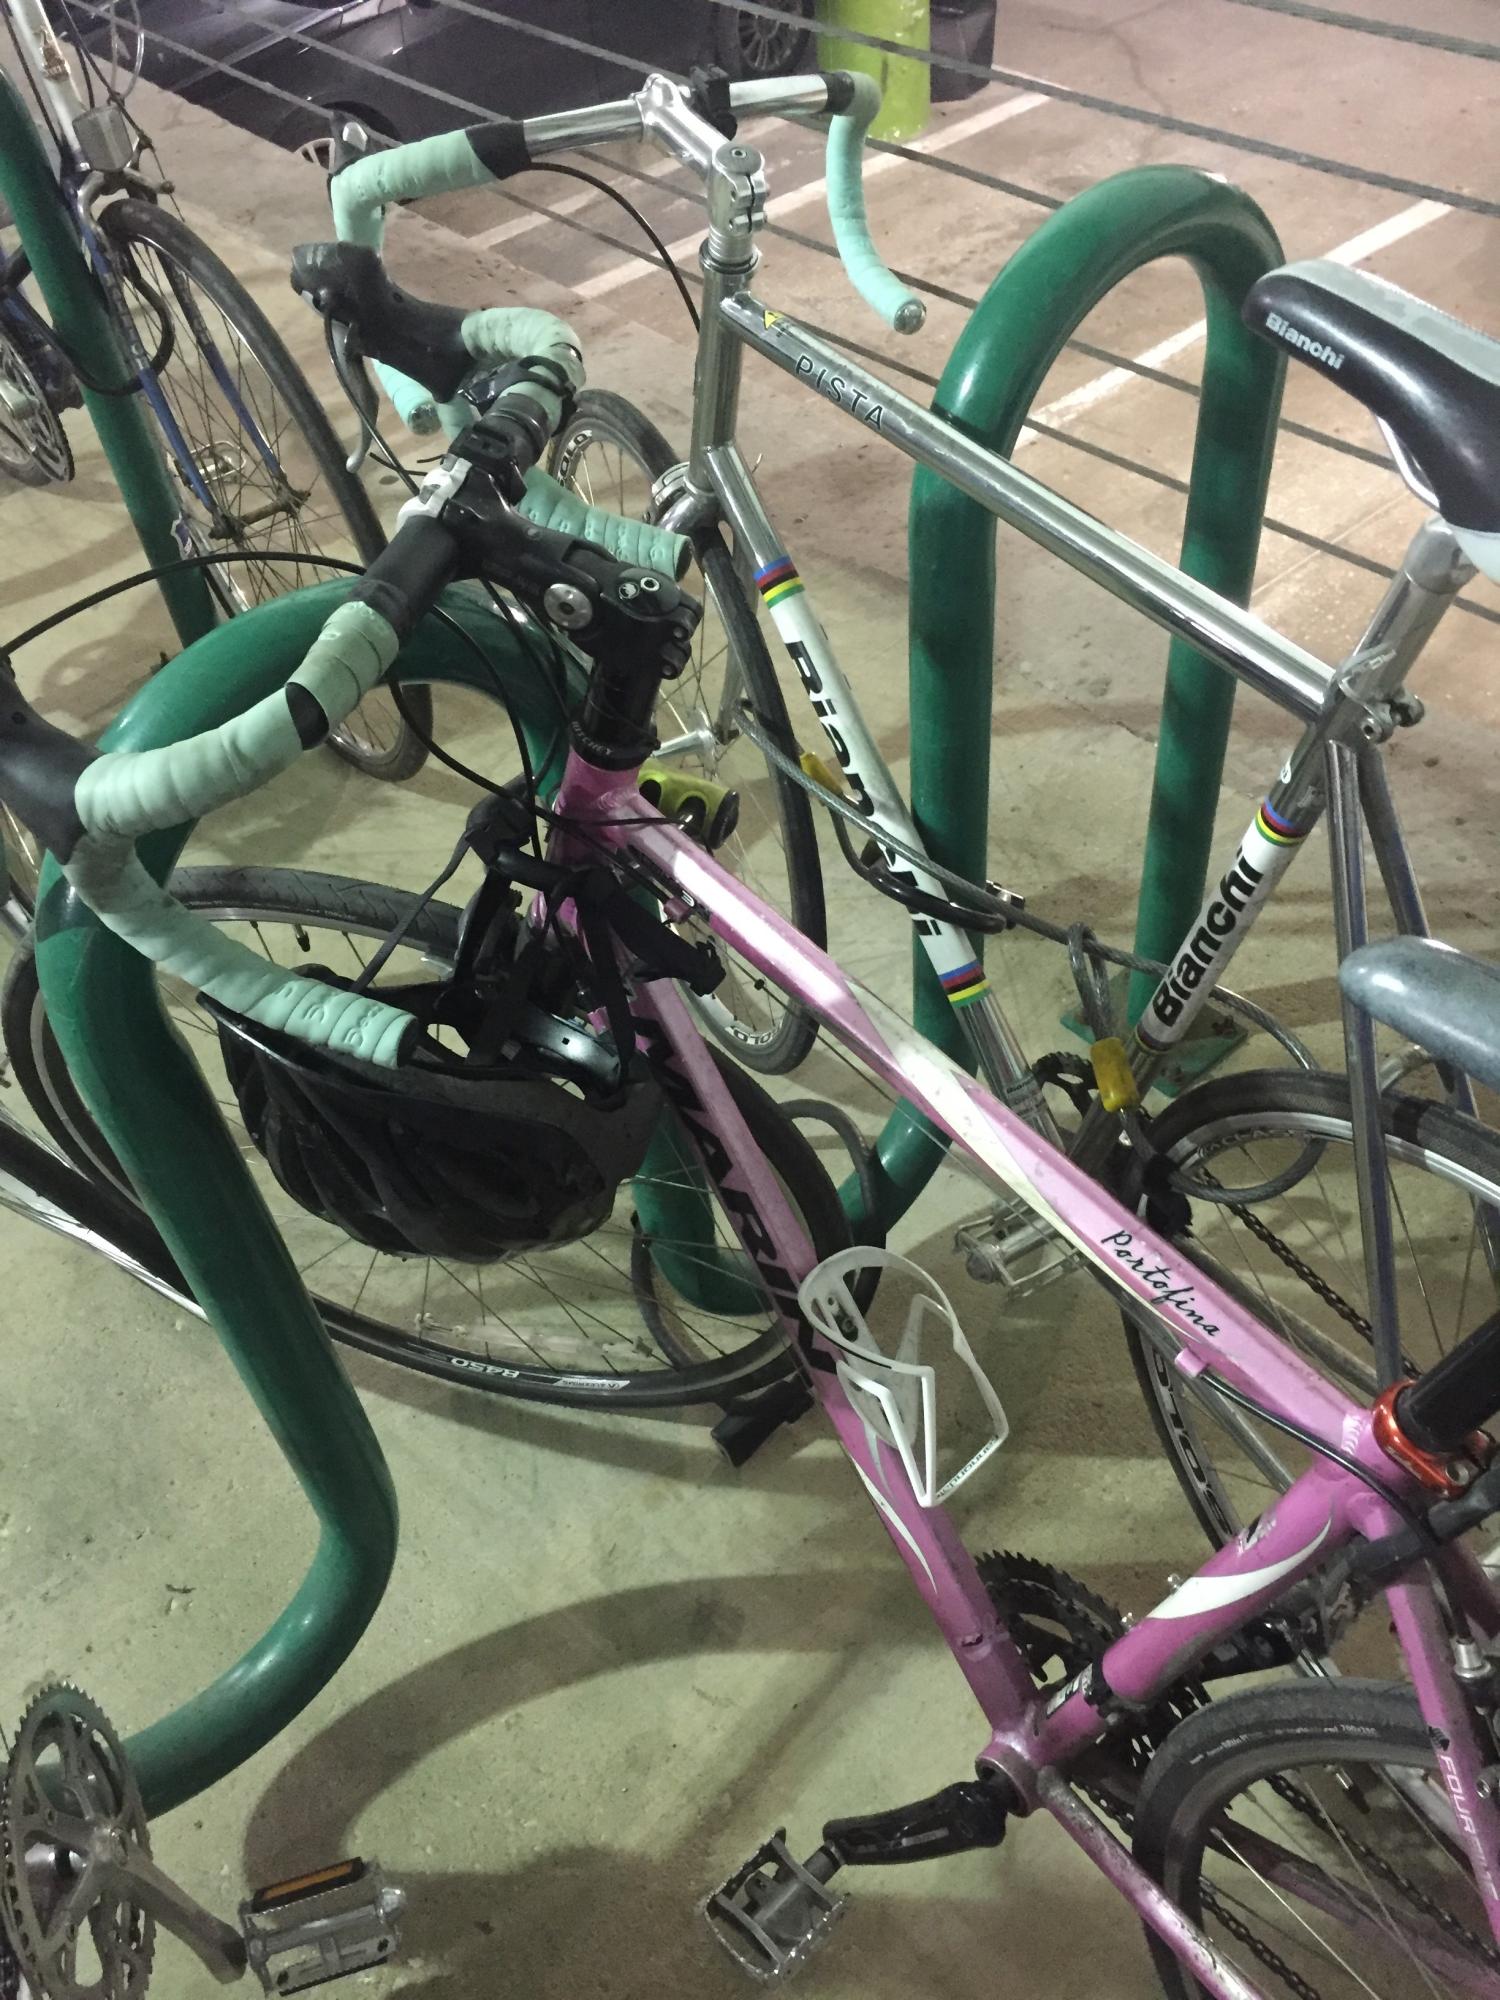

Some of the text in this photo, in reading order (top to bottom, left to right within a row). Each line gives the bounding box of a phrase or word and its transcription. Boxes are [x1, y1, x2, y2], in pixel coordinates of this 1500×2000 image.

[1265, 312, 1345, 370] Bianchi
[795, 354, 885, 430] PISTA
[558, 431, 590, 488] OLO
[1152, 845, 1264, 1028] Bianchi
[626, 1011, 838, 1380] MARIN
[1100, 1229, 1221, 1337] Portofina
[449, 1357, 520, 1379] R450
